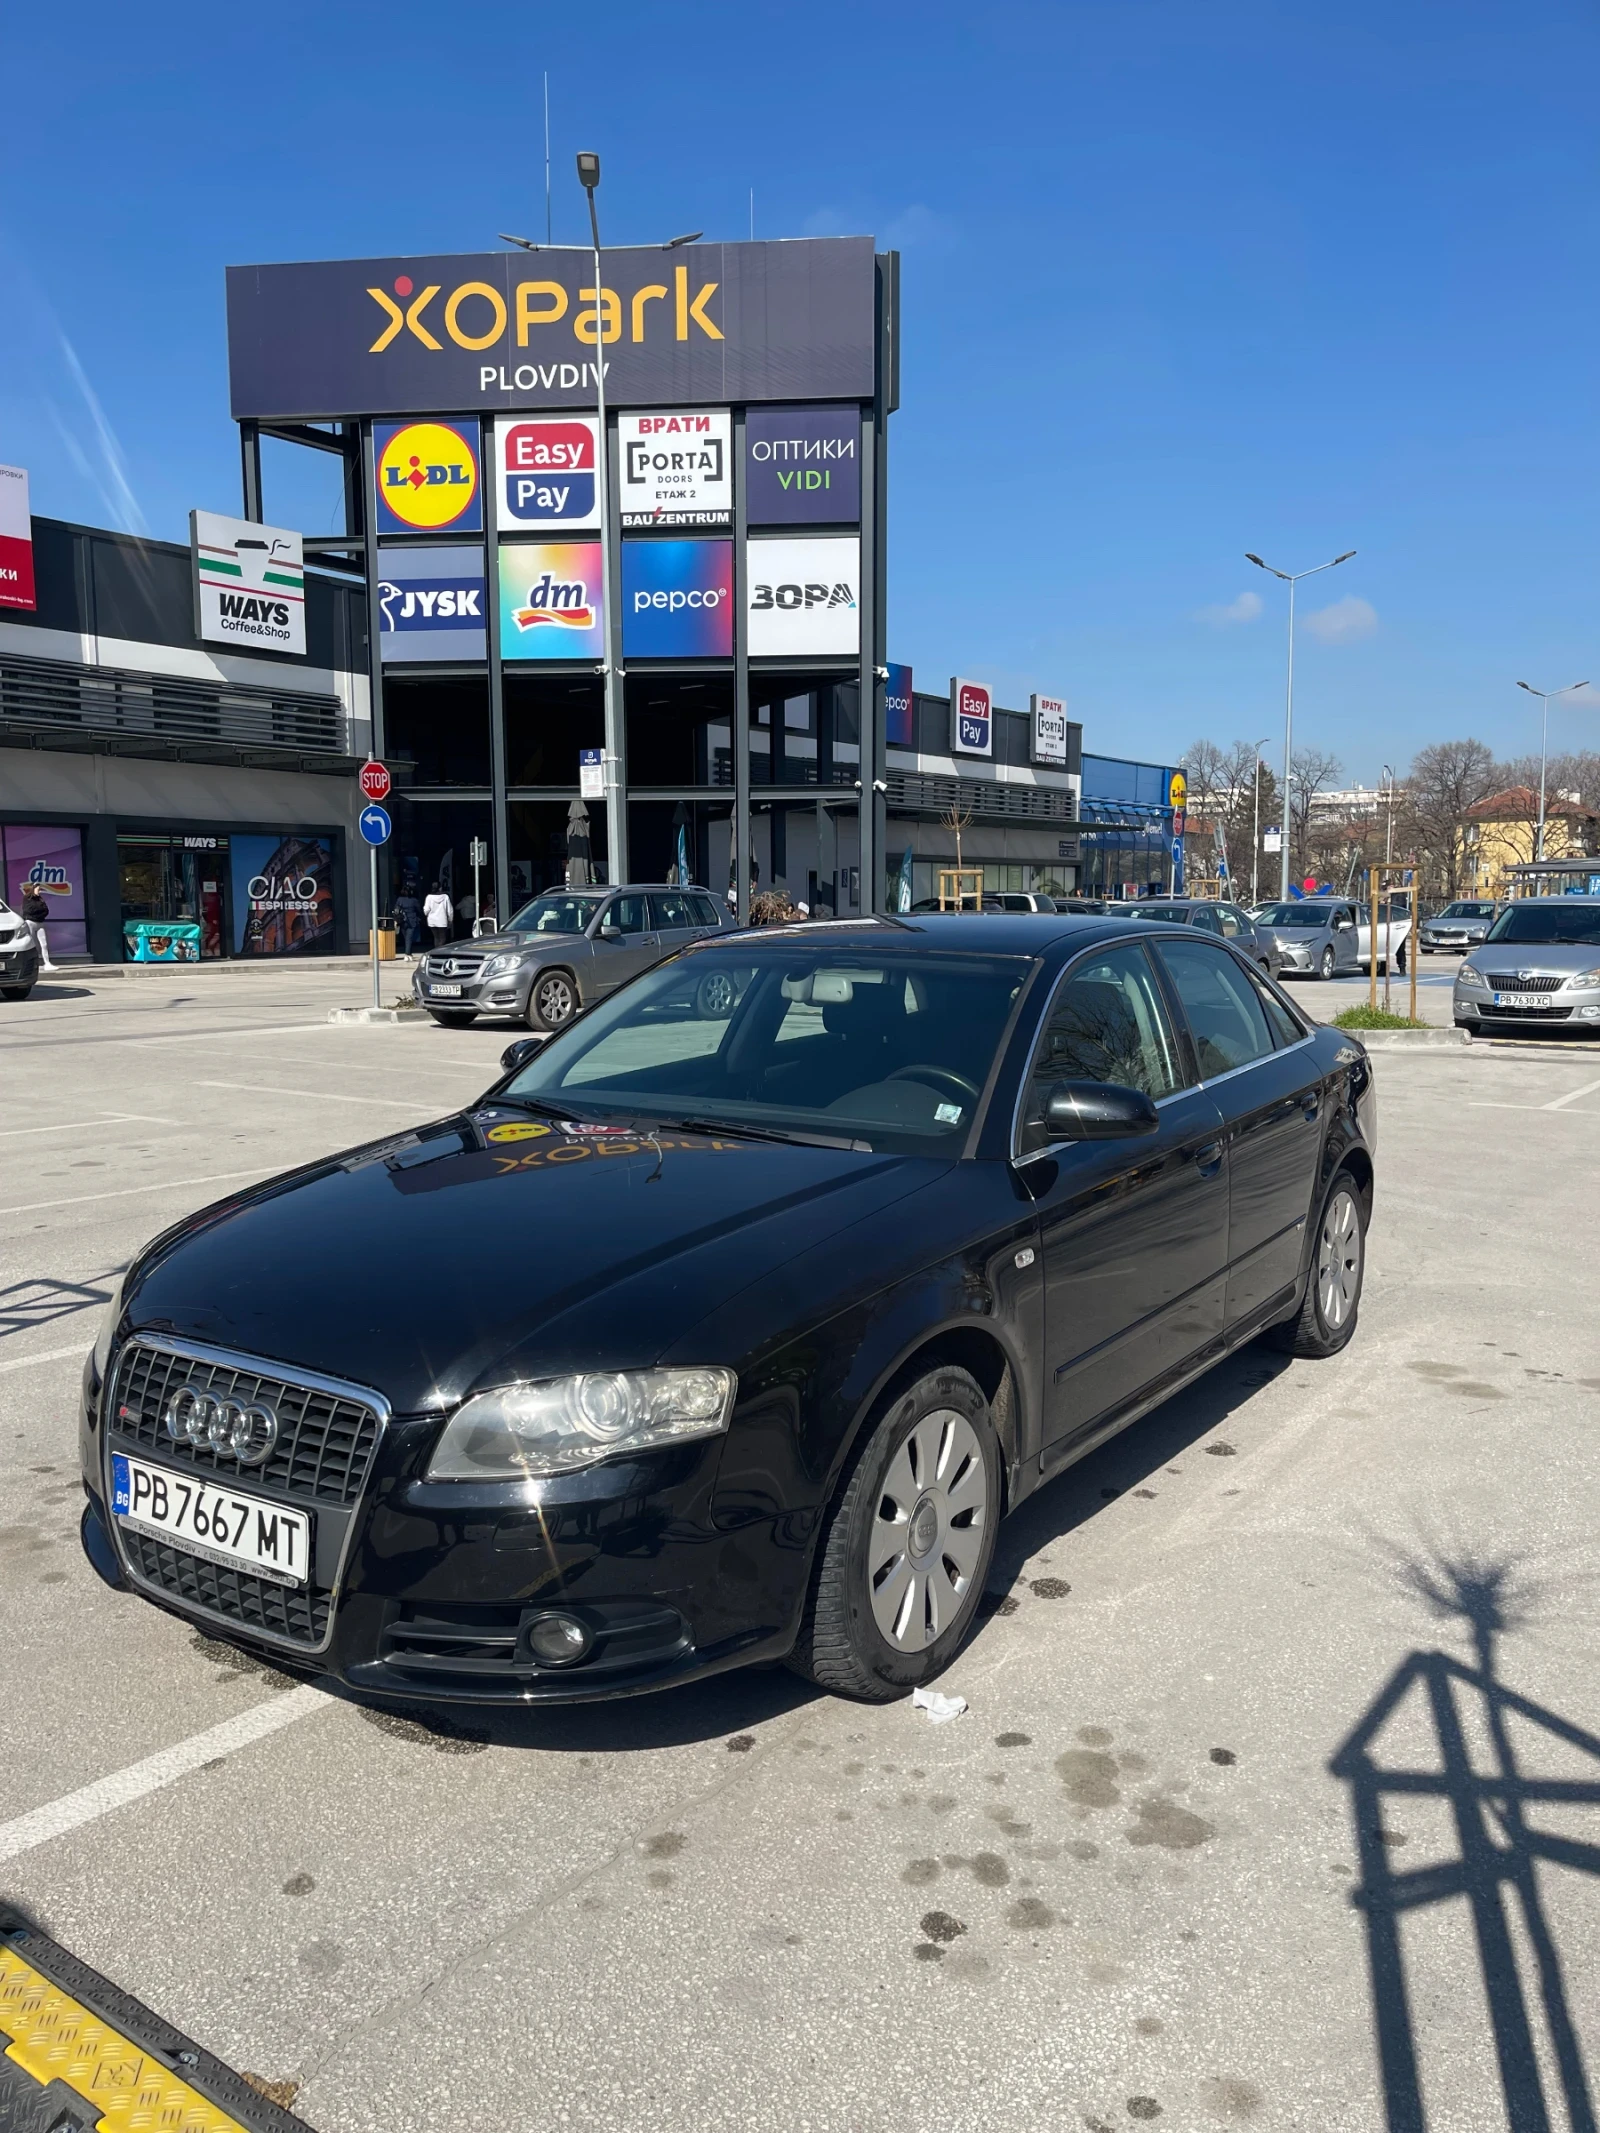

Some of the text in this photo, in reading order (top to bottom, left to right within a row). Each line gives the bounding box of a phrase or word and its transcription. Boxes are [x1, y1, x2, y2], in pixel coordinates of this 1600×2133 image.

[480, 363, 610, 391] PLOVDIV
[638, 416, 710, 434] ВРАТИ
[516, 436, 585, 468] Easy
[752, 439, 854, 461] ОПТИКИ
[638, 452, 713, 471] PORTA
[657, 475, 693, 483] DOORS
[776, 470, 831, 490] VIDI
[517, 480, 570, 513] Pay
[655, 490, 696, 499] ЕТАЖ 2
[656, 512, 729, 525] ZENTRUM
[529, 574, 583, 608] dm
[219, 593, 290, 626] WAYS
[400, 589, 481, 617] JYSK
[221, 618, 290, 640] Coffee&Shop
[963, 692, 987, 717] Easy
[963, 720, 981, 744] Pay
[363, 772, 388, 789] STOP
[184, 837, 217, 848] WAYS
[30, 862, 65, 883] dm
[247, 875, 318, 900] CIAO
[116, 1491, 129, 1507] BG
[138, 1523, 167, 1541] Porsche
[168, 1536, 196, 1553] Plovdiv
